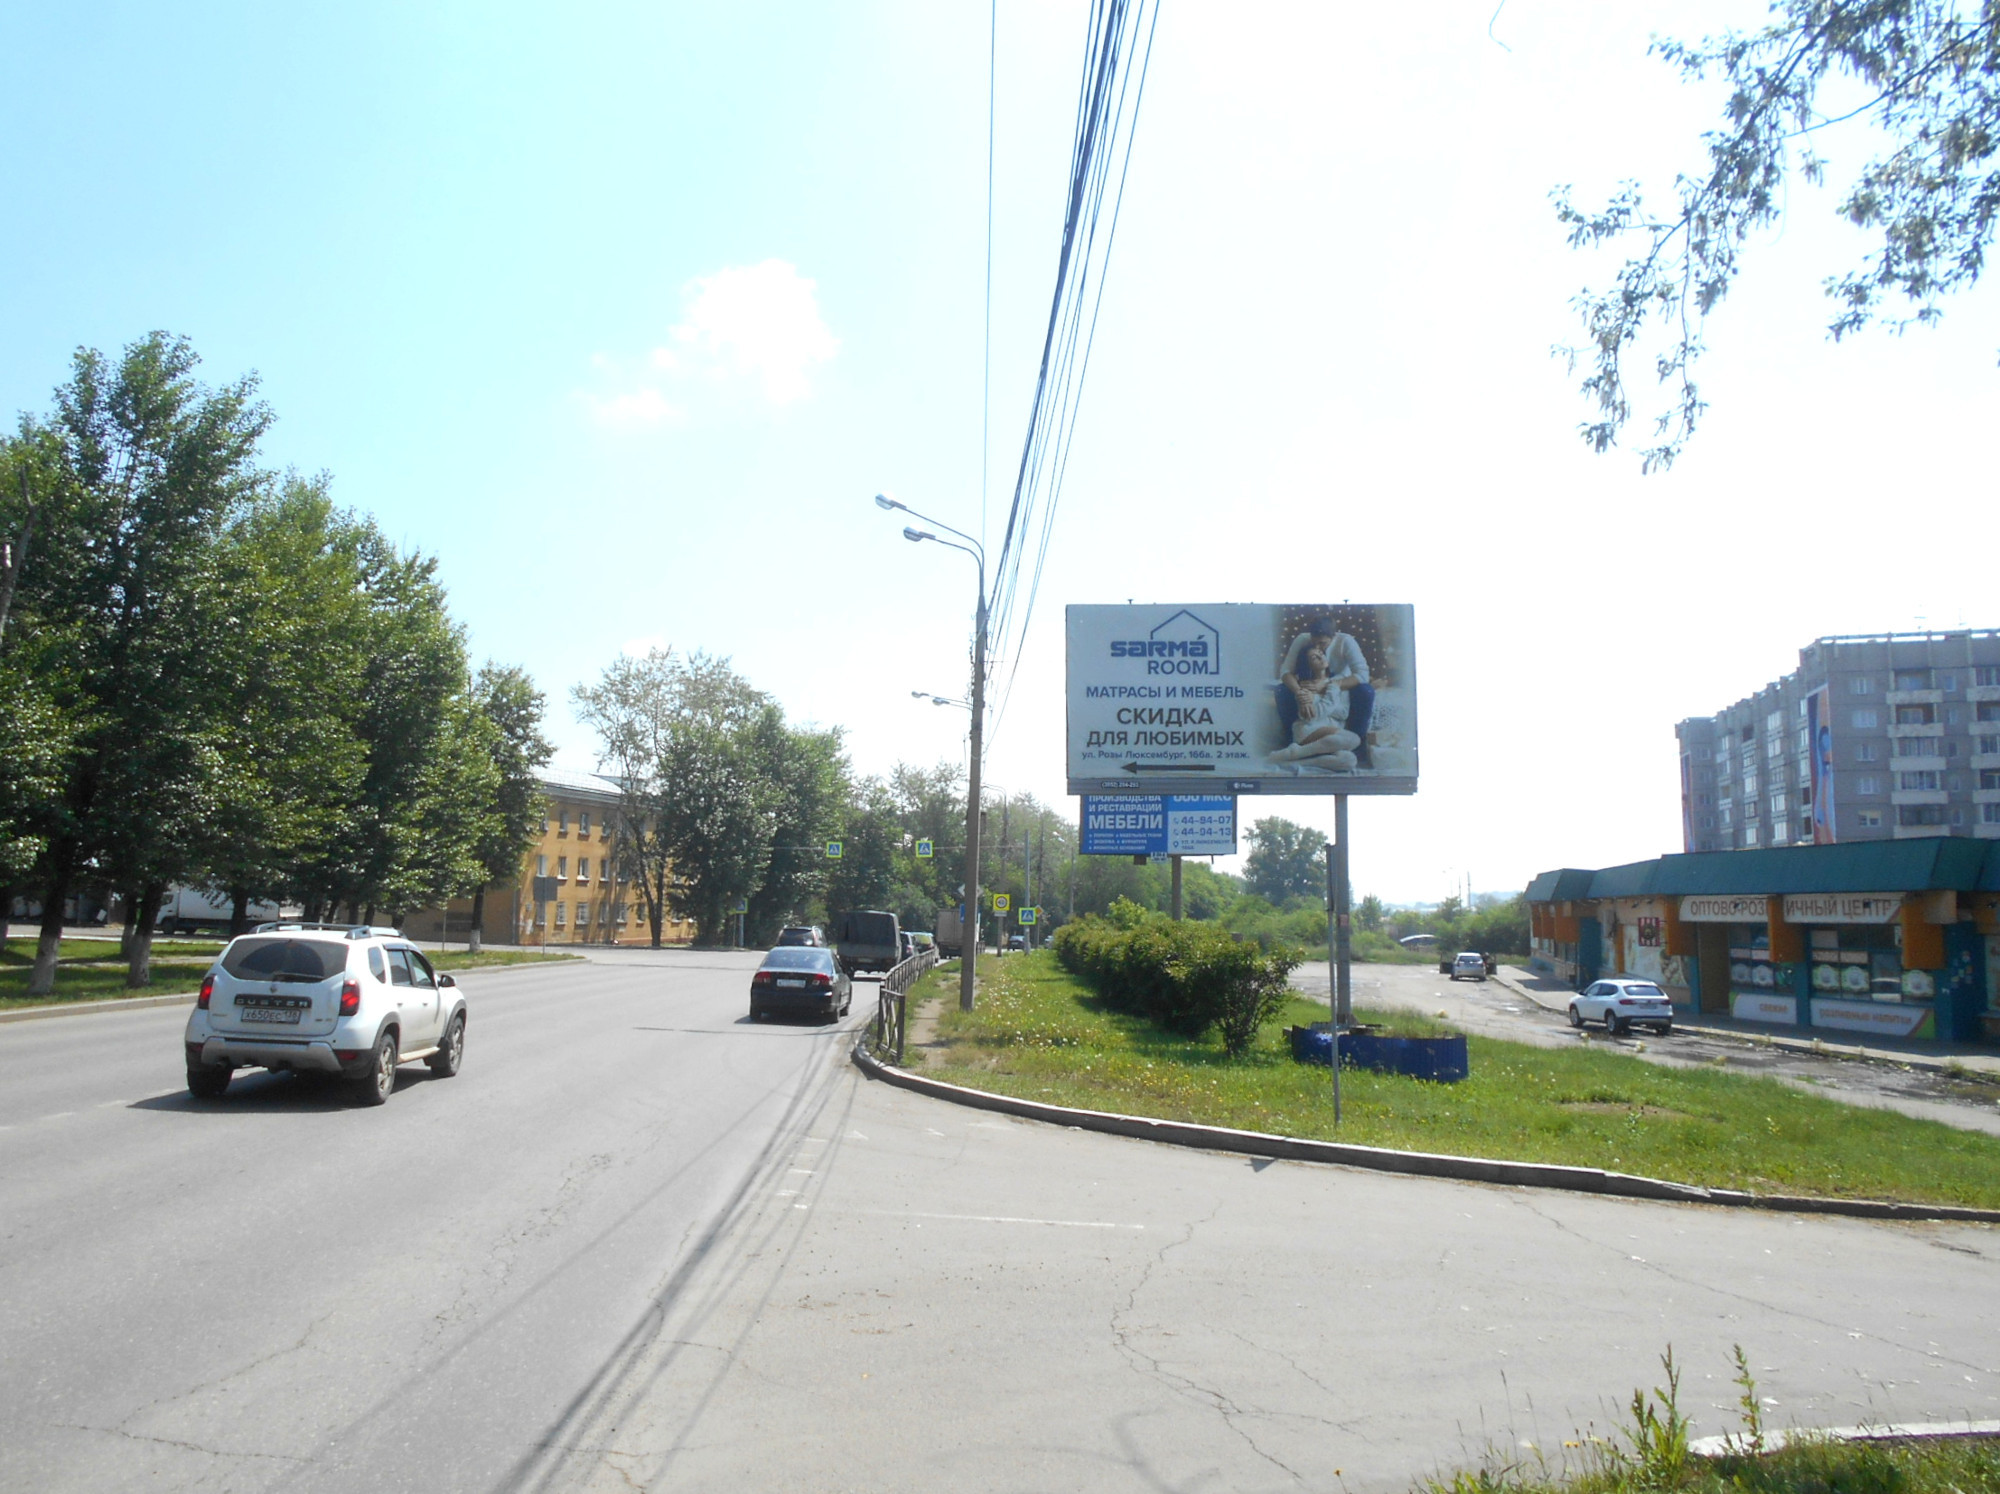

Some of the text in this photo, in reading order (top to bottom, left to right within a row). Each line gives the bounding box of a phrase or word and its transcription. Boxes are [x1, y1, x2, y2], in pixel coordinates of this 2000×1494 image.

[1147, 660, 1209, 675] ROOM
[1086, 686, 1244, 699] МАТРАСЫ И МЕБЕЛЬ
[1116, 707, 1214, 727] СКИДКА
[1086, 731, 1244, 747] ДЛЯ ЛЮБИМЫХ
[1082, 752, 1096, 760] ул.
[1098, 751, 1123, 759] Розы
[1216, 751, 1224, 759] 2
[1089, 803, 1162, 813] И РЕСТАВРАЦИИ
[1088, 815, 1163, 829] МЕБЕЛИ
[236, 999, 308, 1007] DUSTER
